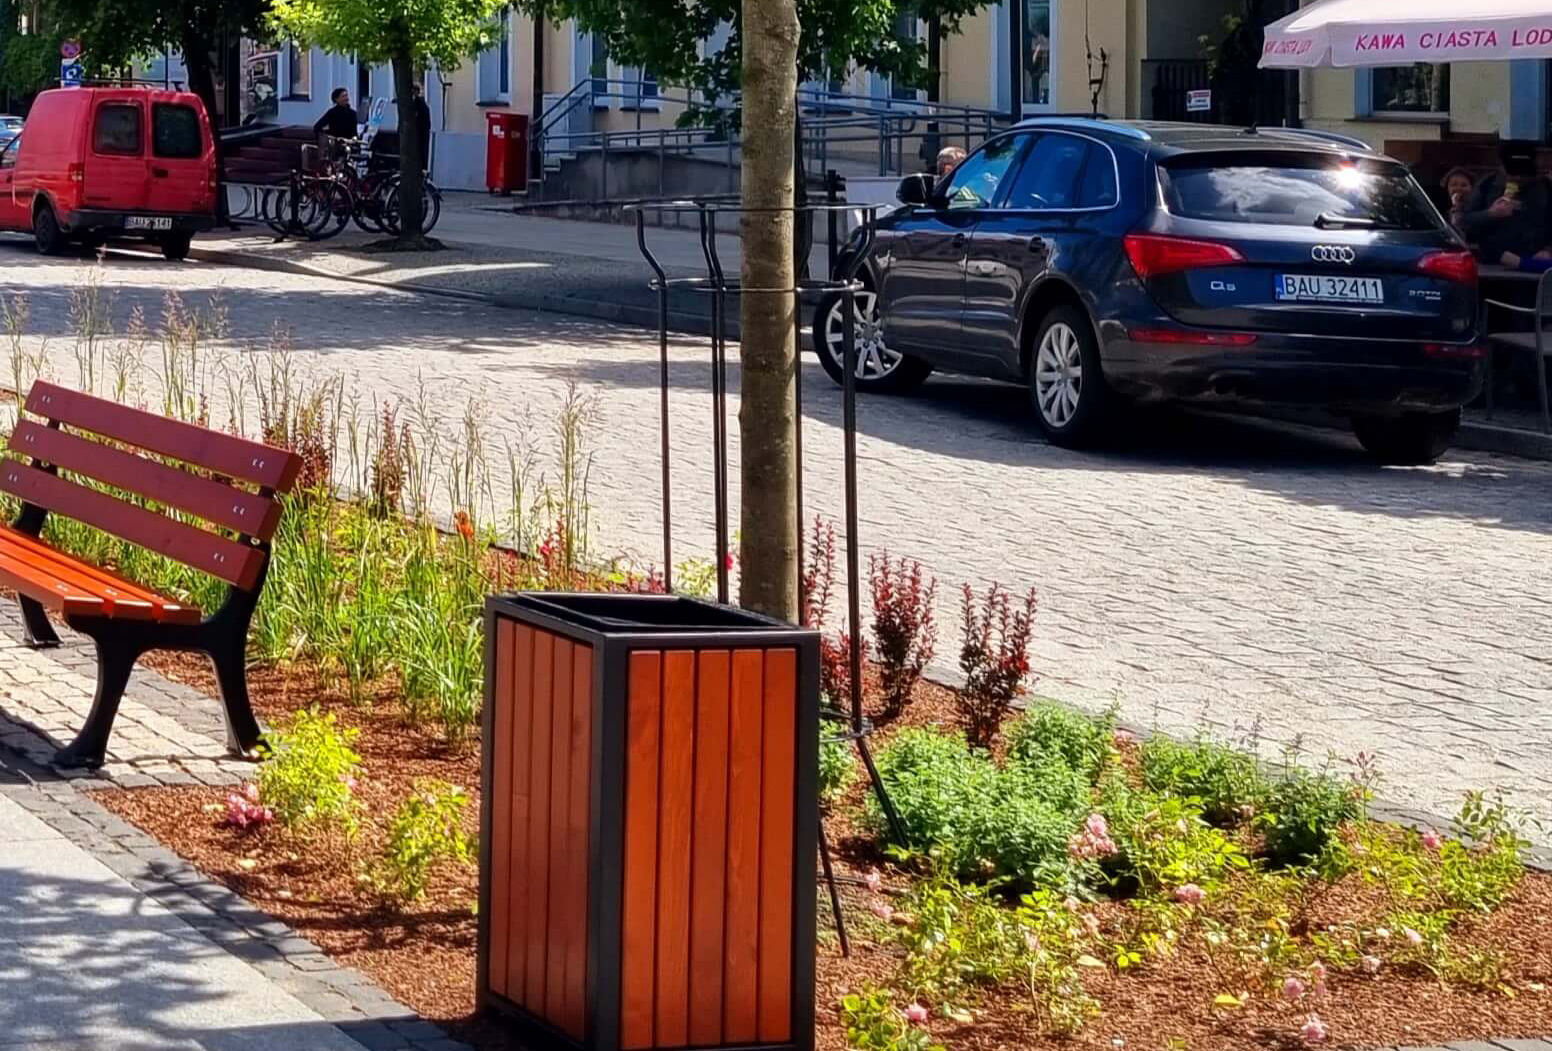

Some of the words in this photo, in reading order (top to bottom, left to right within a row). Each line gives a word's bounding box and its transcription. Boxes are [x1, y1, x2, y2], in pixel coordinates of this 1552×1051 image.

[1355, 33, 1405, 51] KAWA
[1420, 30, 1497, 49] CIASTA
[1284, 277, 1321, 295] BAU
[1326, 278, 1380, 298] 32411
